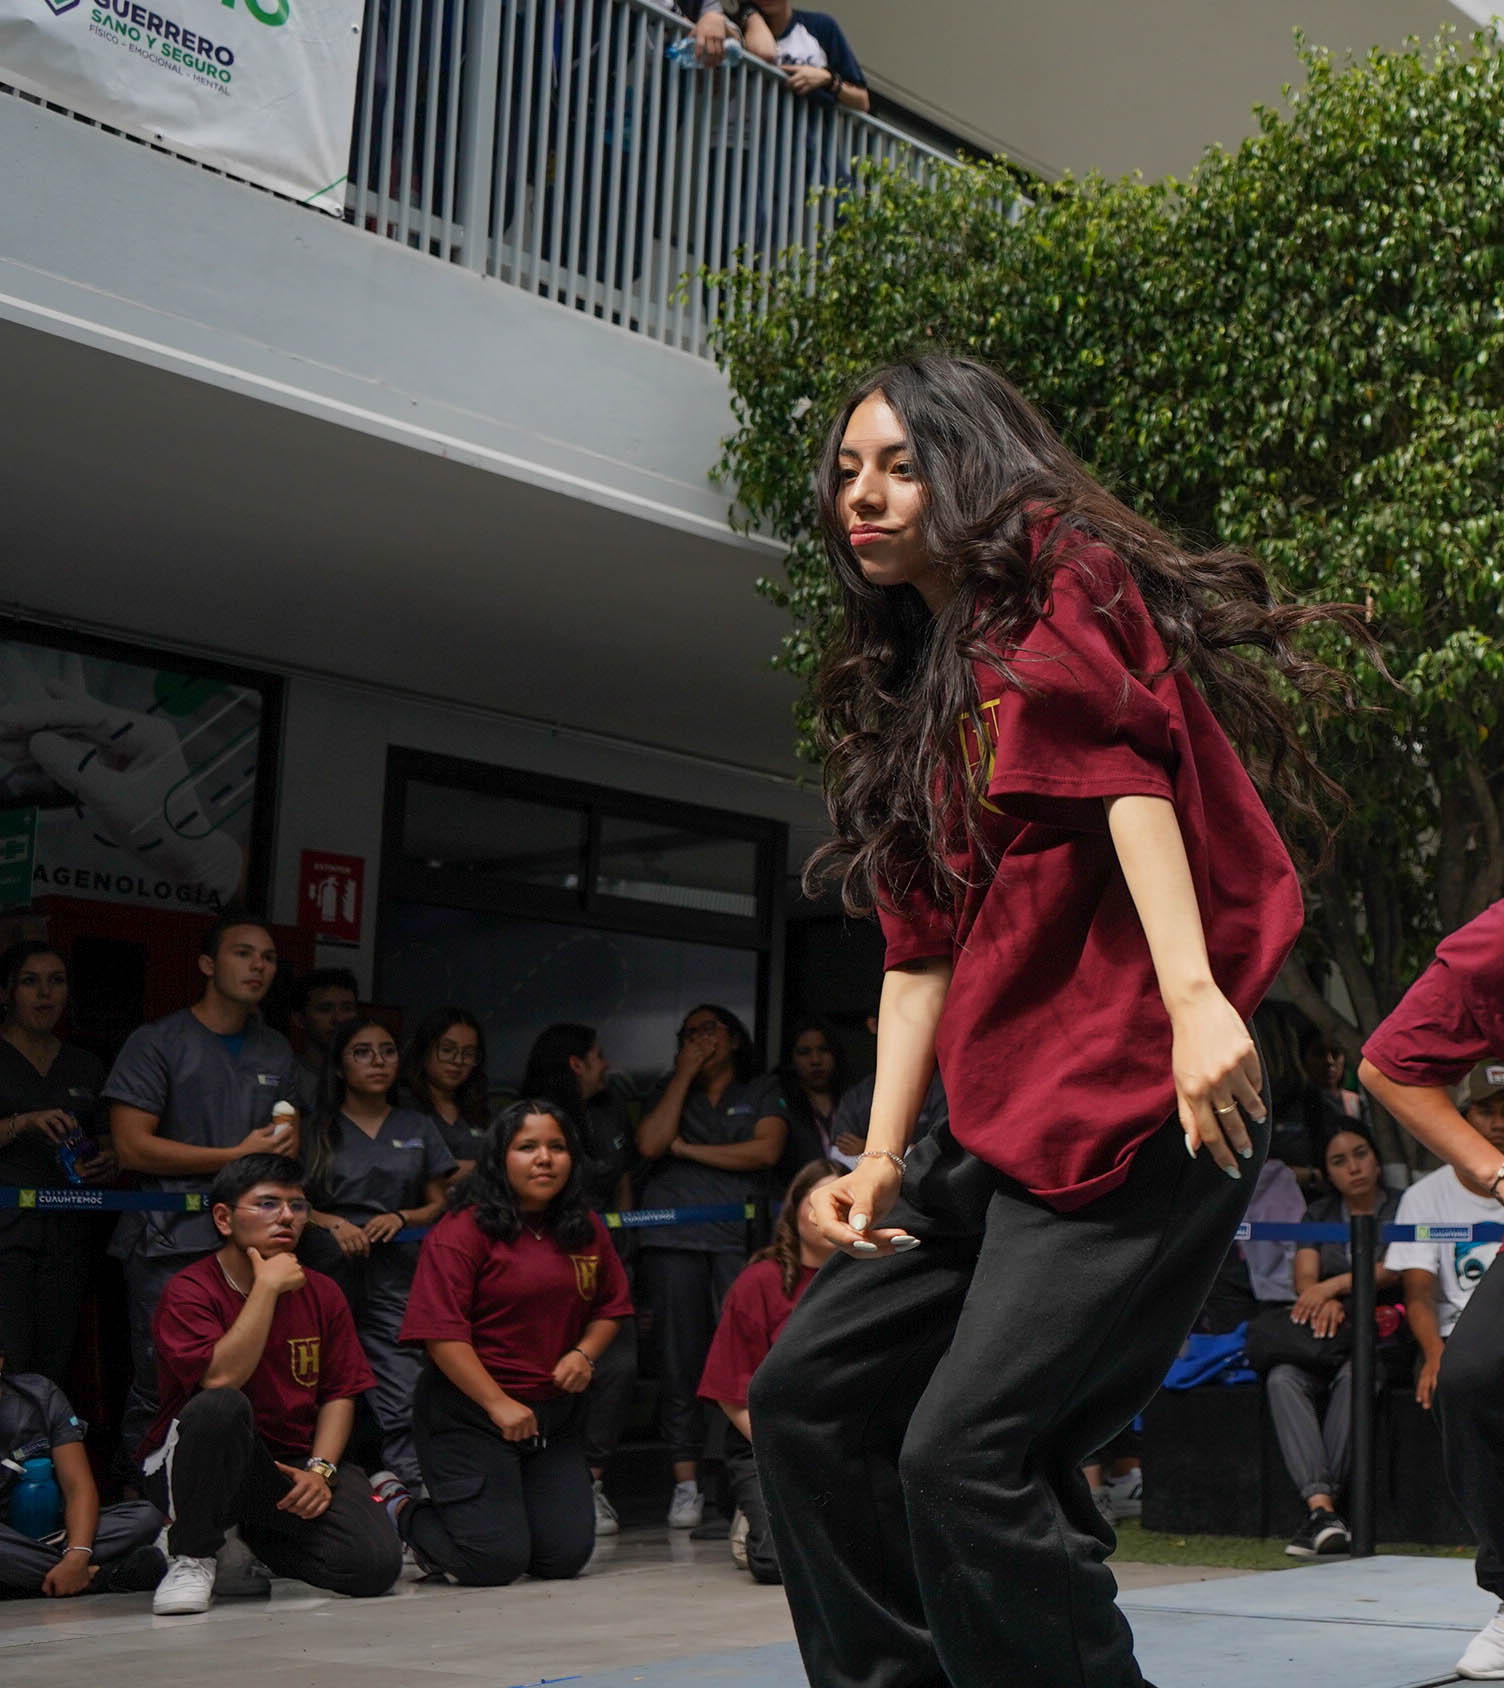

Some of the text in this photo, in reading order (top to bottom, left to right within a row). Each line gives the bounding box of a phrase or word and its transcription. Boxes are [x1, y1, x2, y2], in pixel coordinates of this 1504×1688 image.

[91, 9, 232, 84] SANO Y SEGURO
[128, 44, 183, 76] EMOCIONAL
[192, 73, 231, 97] MENTAL
[297, 1334, 320, 1376] H
